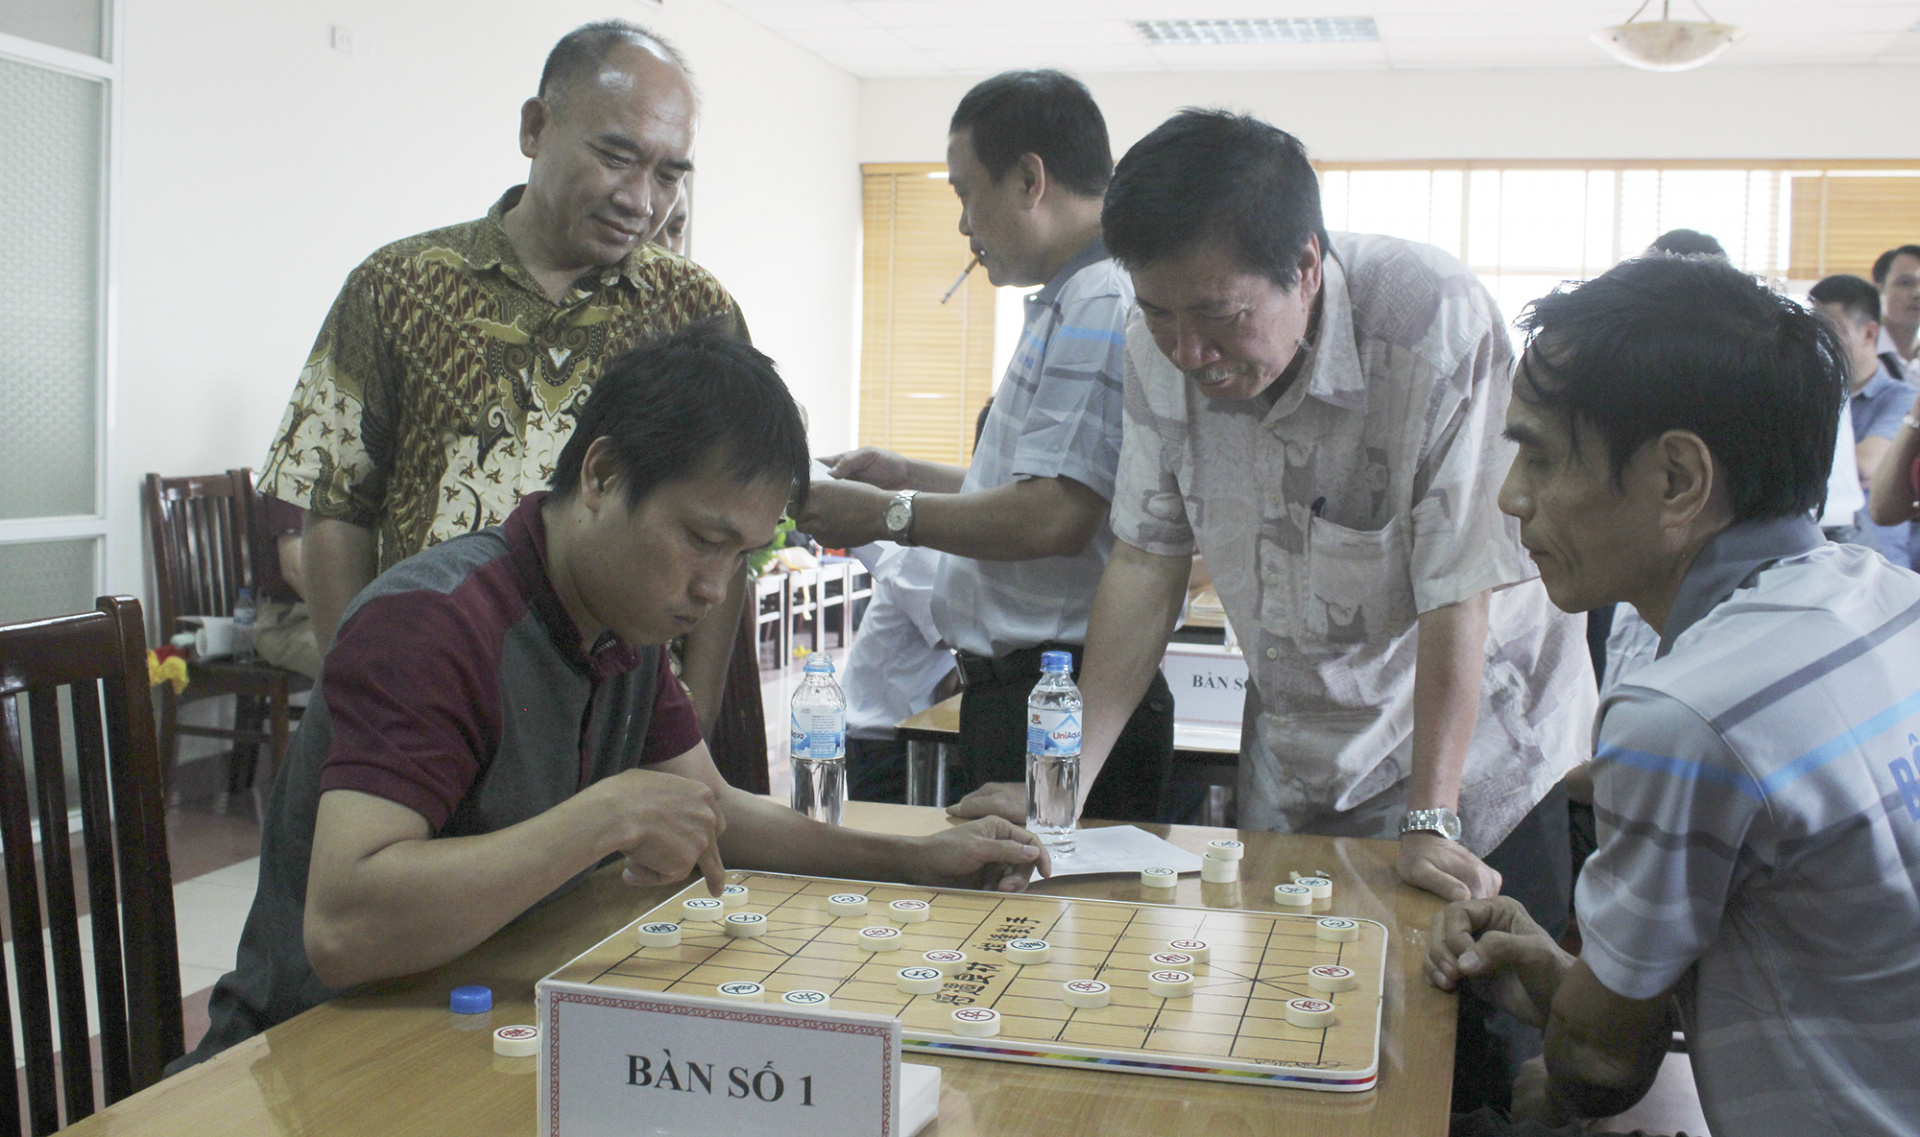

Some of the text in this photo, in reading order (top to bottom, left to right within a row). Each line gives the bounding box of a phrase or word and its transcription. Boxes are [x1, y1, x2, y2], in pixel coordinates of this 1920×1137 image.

[1192, 671, 1246, 691] BÀN S
[626, 1048, 816, 1106] BÀN SỐ 1
